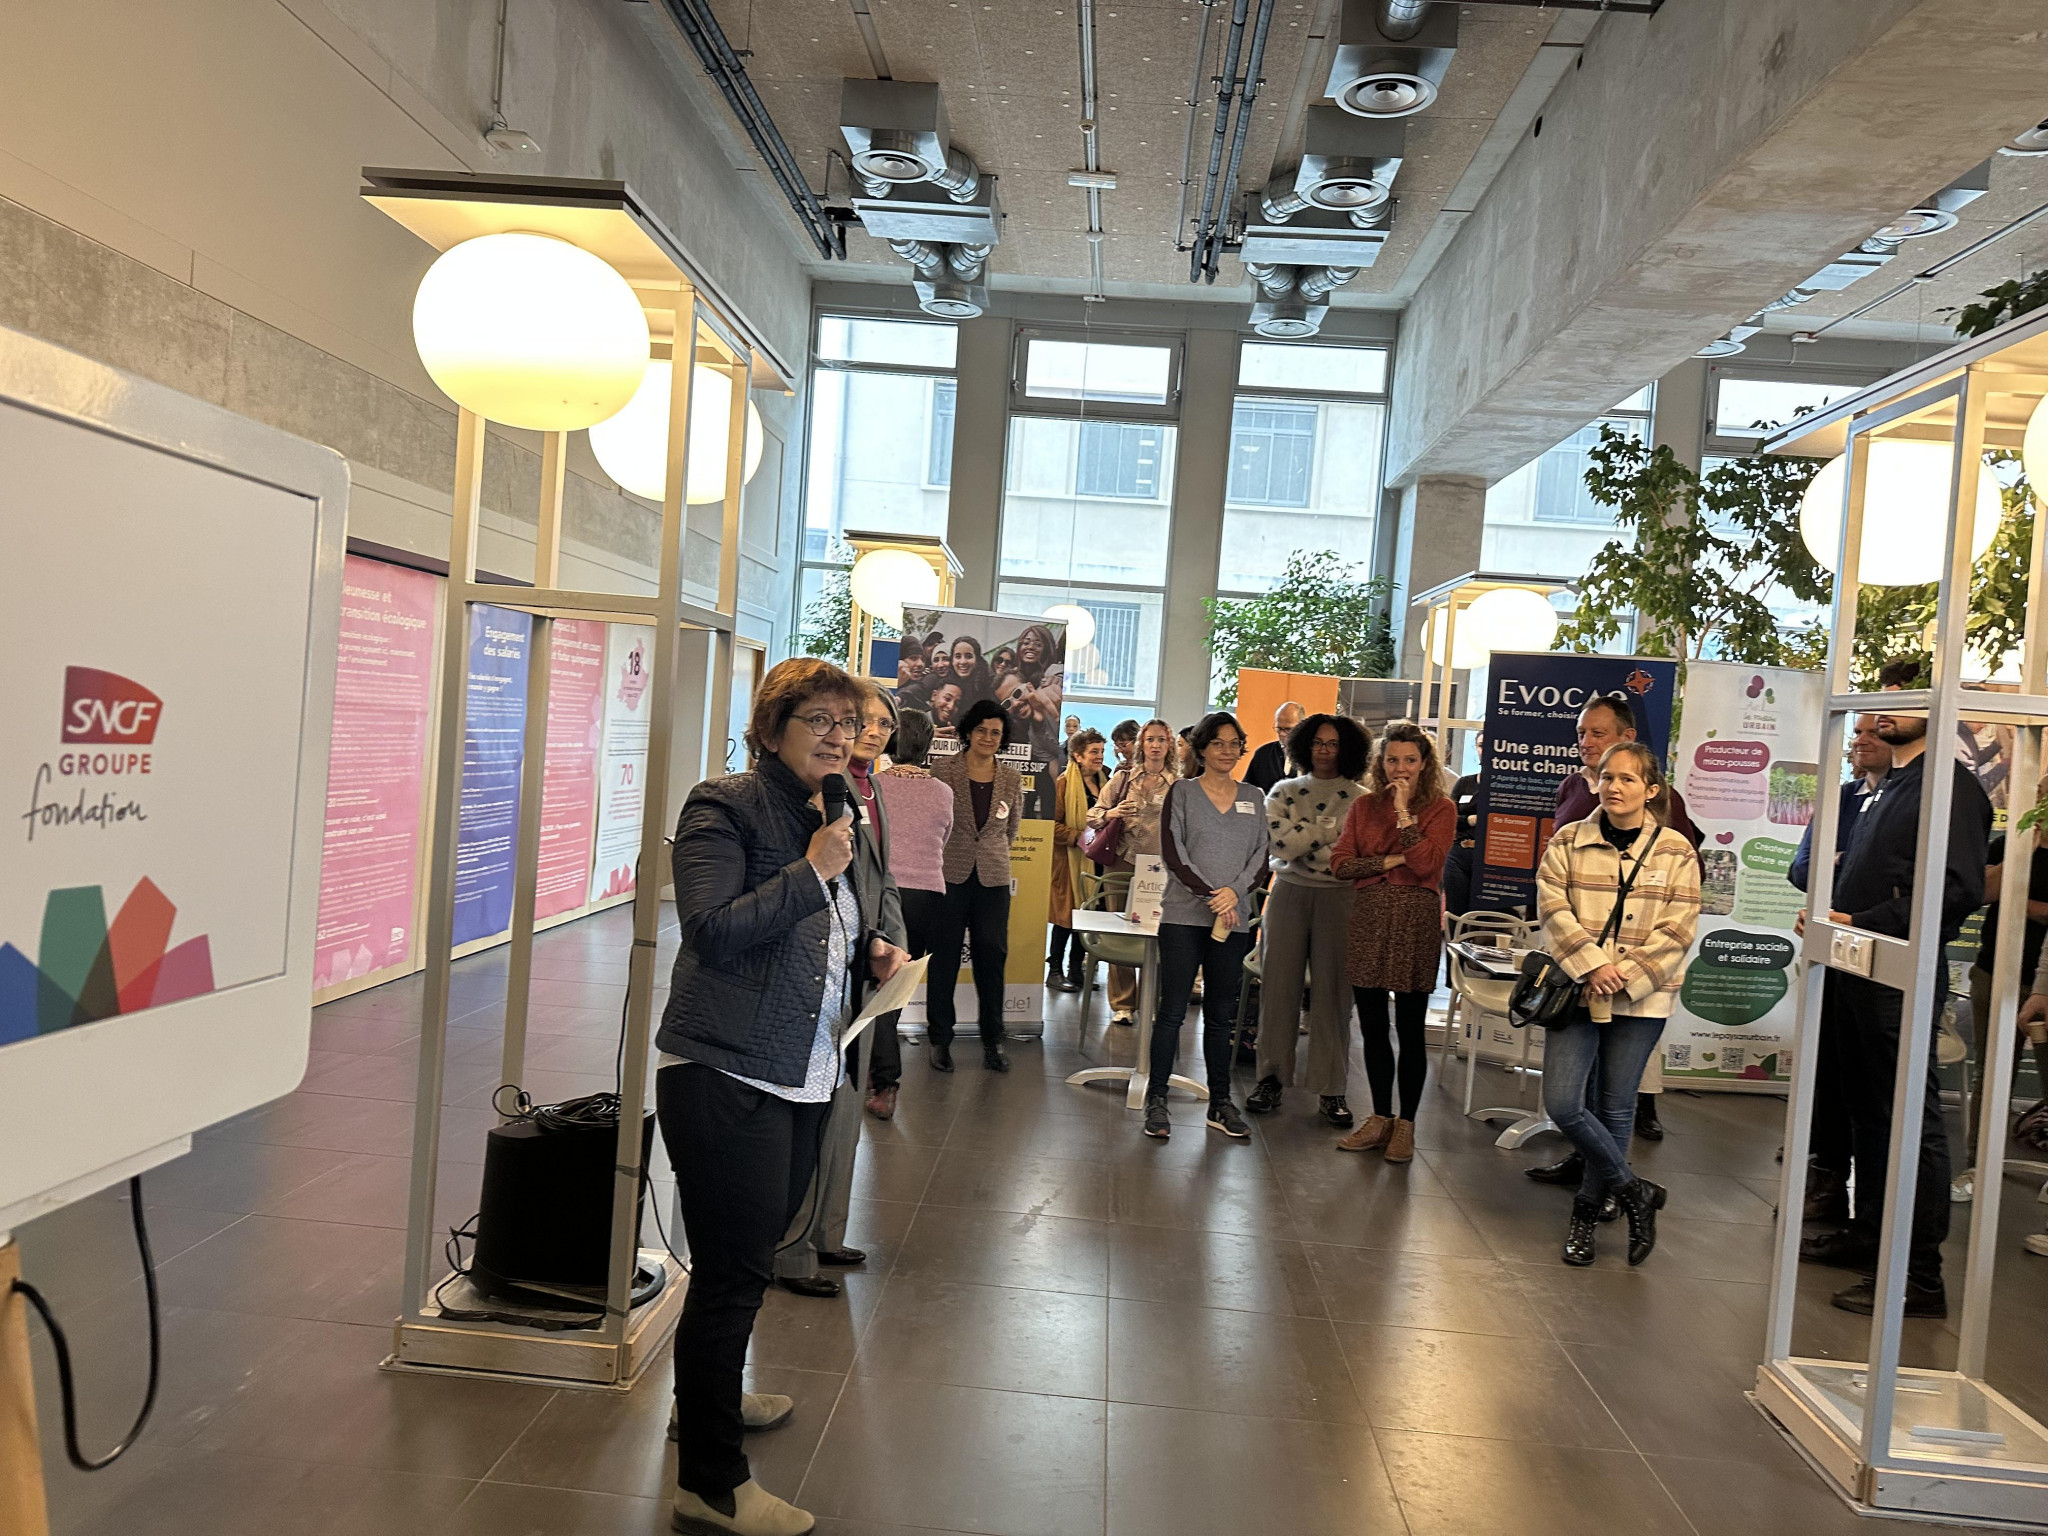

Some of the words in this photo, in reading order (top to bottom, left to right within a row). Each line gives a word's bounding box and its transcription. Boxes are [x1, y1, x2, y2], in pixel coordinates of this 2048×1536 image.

[341, 606, 380, 622] ransition
[382, 609, 427, 632] écologique
[485, 625, 525, 643] Engagement
[483, 643, 496, 656] des
[497, 645, 521, 659] salariés
[628, 651, 640, 676] 18
[65, 698, 157, 735] SNCF
[1497, 707, 1509, 716] Se
[1511, 708, 1545, 719] former,
[1493, 739, 1530, 754] Une
[1532, 743, 1580, 758] anné
[1704, 745, 1750, 755] Producteur
[1751, 747, 1763, 756] de
[59, 753, 152, 776] GROUPE
[1491, 757, 1530, 772] tout
[1533, 759, 1580, 775] chan
[1702, 758, 1760, 768] micro-pousses
[621, 763, 634, 786] 70
[22, 762, 148, 842] fondation
[1747, 854, 1776, 865] nature
[1137, 880, 1165, 891] Artic
[1705, 938, 1753, 951] Entreprise
[1755, 942, 1790, 952] sociale
[1717, 954, 1728, 962] et
[1730, 954, 1771, 965] solidaire
[1004, 996, 1031, 1010] cle1
